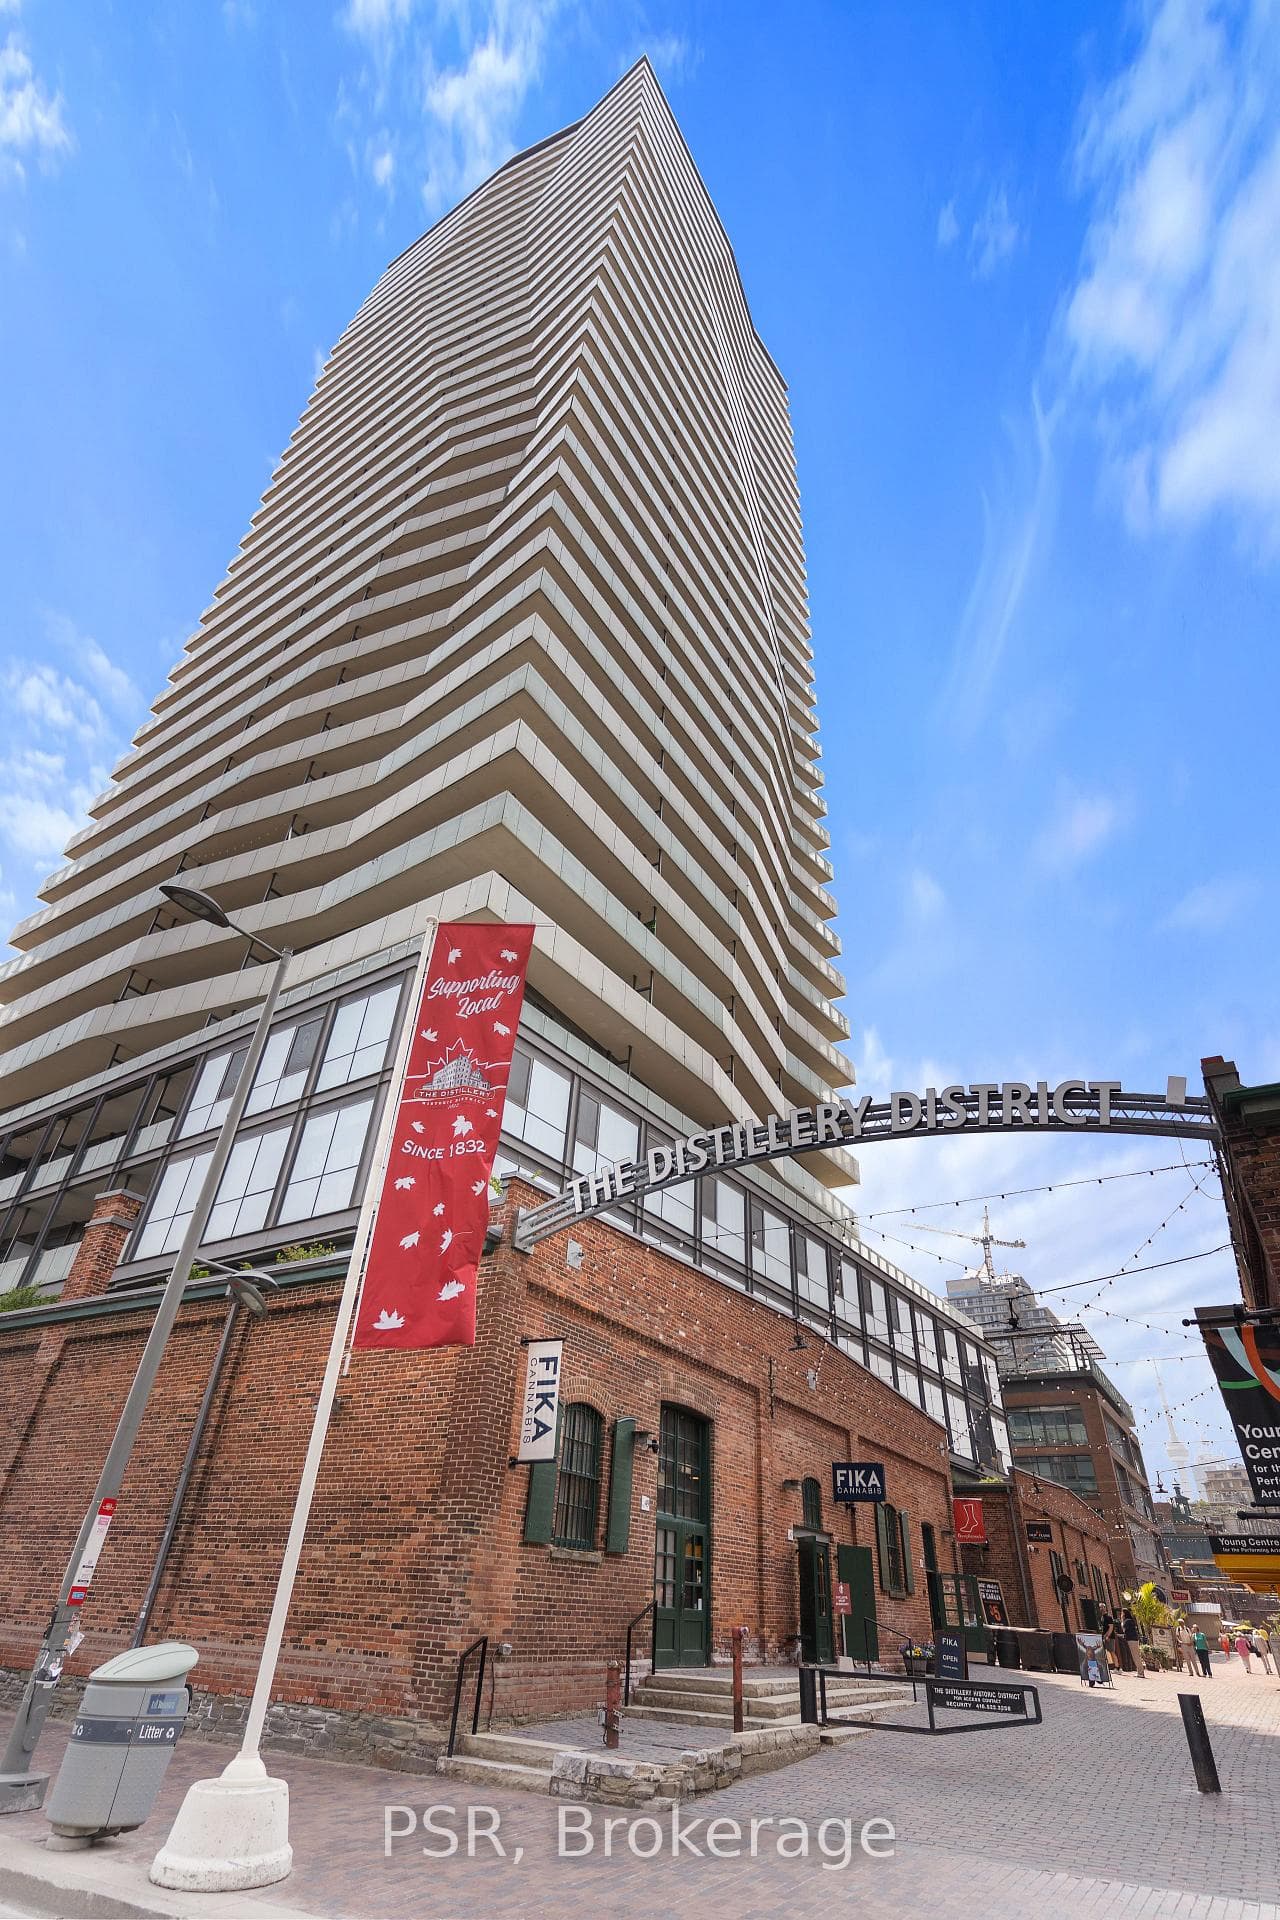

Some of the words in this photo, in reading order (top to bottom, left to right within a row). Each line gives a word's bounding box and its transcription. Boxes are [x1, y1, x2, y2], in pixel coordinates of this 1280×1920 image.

[427, 970, 520, 999] Supporting
[456, 991, 504, 1019] Local
[440, 1085, 493, 1097] DISTILLERY
[401, 1139, 445, 1160] SINCE
[449, 1139, 487, 1158] 1832
[567, 1155, 637, 1214] THE
[647, 1095, 873, 1185] DISTILLERY
[890, 1080, 1122, 1133] DISTRICT
[522, 1356, 538, 1444] CANNABIS
[532, 1356, 559, 1443] FIKA
[1253, 1464, 1268, 1473] for
[836, 1469, 881, 1487] FIKA
[837, 1487, 882, 1495] CANNABIS
[1218, 1537, 1247, 1548] Young
[1248, 1537, 1280, 1546] Centre
[942, 1637, 958, 1647] FIKA
[942, 1654, 959, 1663] OPEN
[945, 1688, 972, 1696] DISTILLERY
[997, 1692, 1021, 1700] DISTRICT
[946, 1700, 971, 1708] SECURITY
[139, 1724, 164, 1739] Litter
